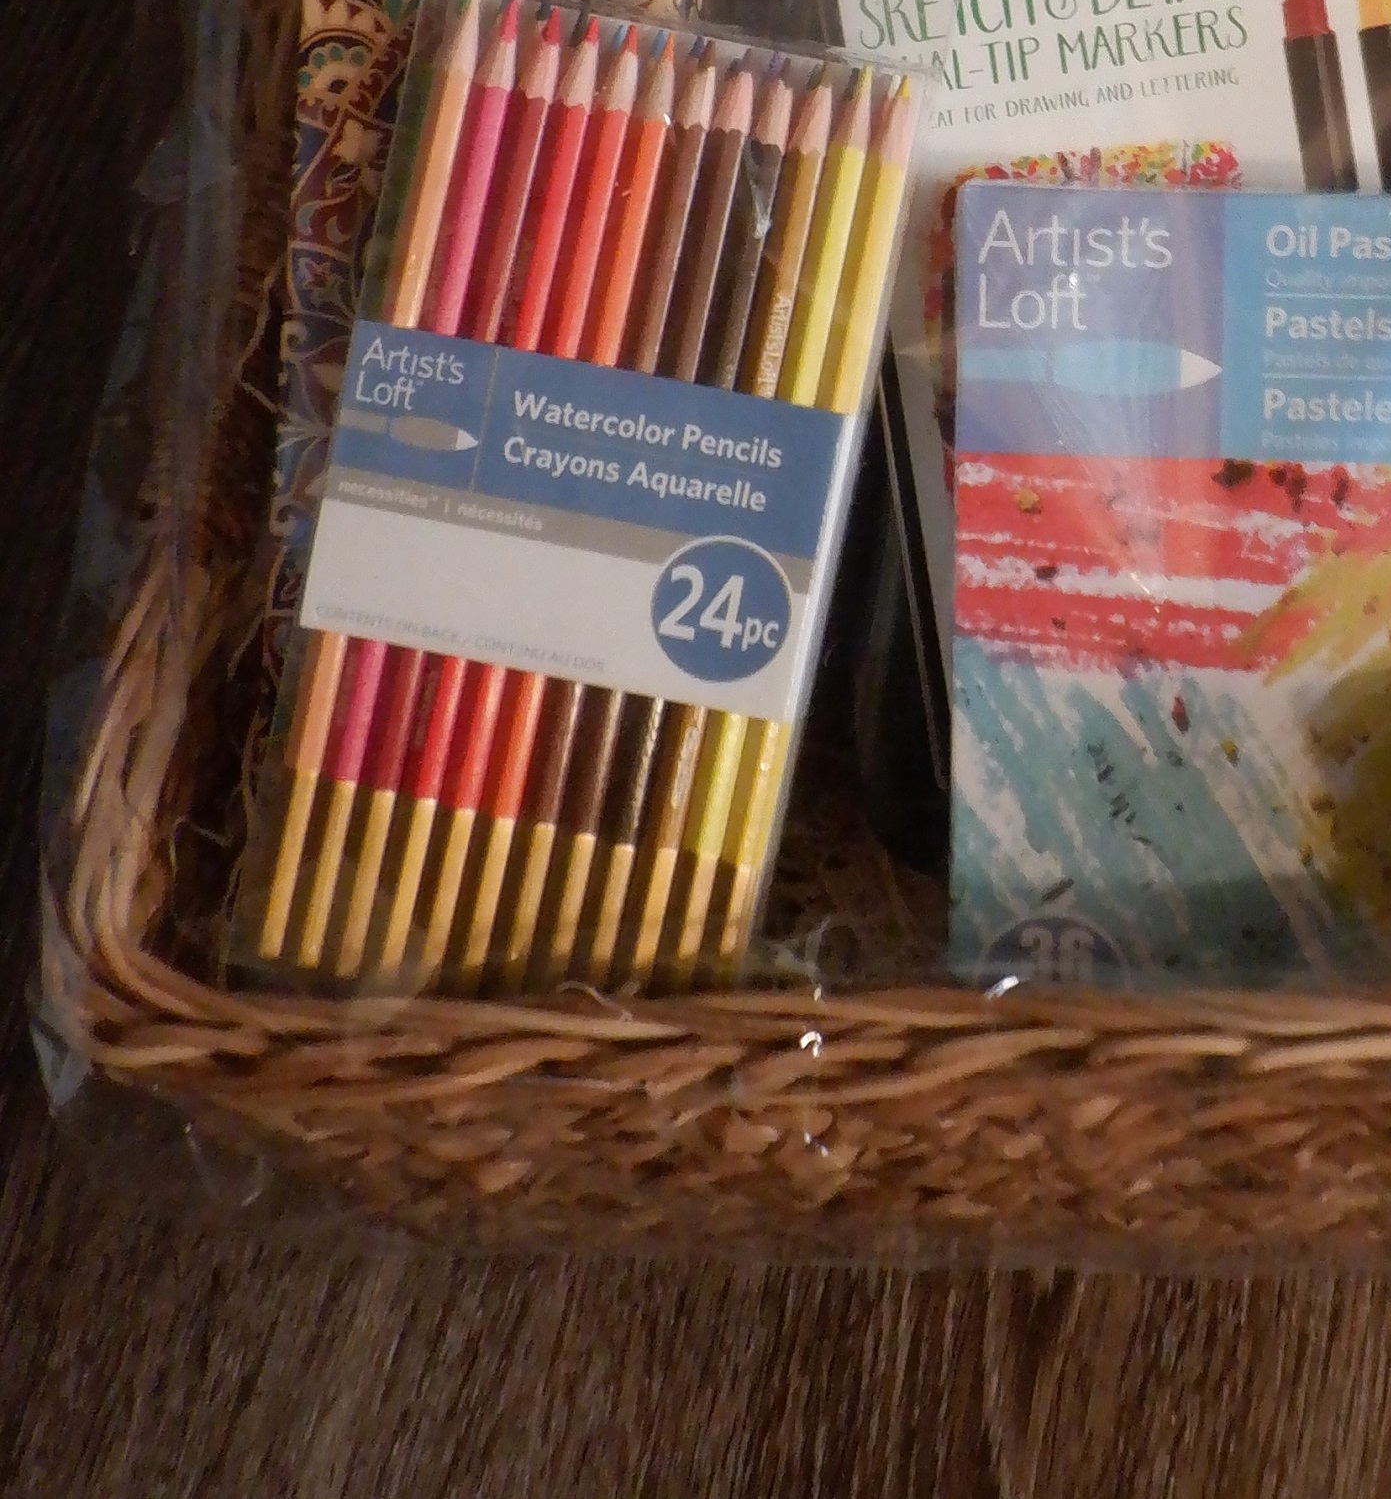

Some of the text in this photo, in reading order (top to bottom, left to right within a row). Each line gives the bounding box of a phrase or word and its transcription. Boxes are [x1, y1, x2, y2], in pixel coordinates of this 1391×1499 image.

[912, 6, 1248, 92] AL-TIP MARKERS
[965, 102, 998, 123] FOR
[1005, 89, 1090, 119] DRAWING
[1097, 81, 1134, 104] AND
[1140, 67, 1240, 98] LETTERING
[977, 209, 1173, 269] Artist's
[1265, 225, 1318, 258] Oil
[361, 337, 465, 386] Artist's
[513, 388, 783, 469] Watercolor Pencils
[503, 435, 768, 512] Crayons Aquarelle
[657, 564, 780, 652] 24pc
